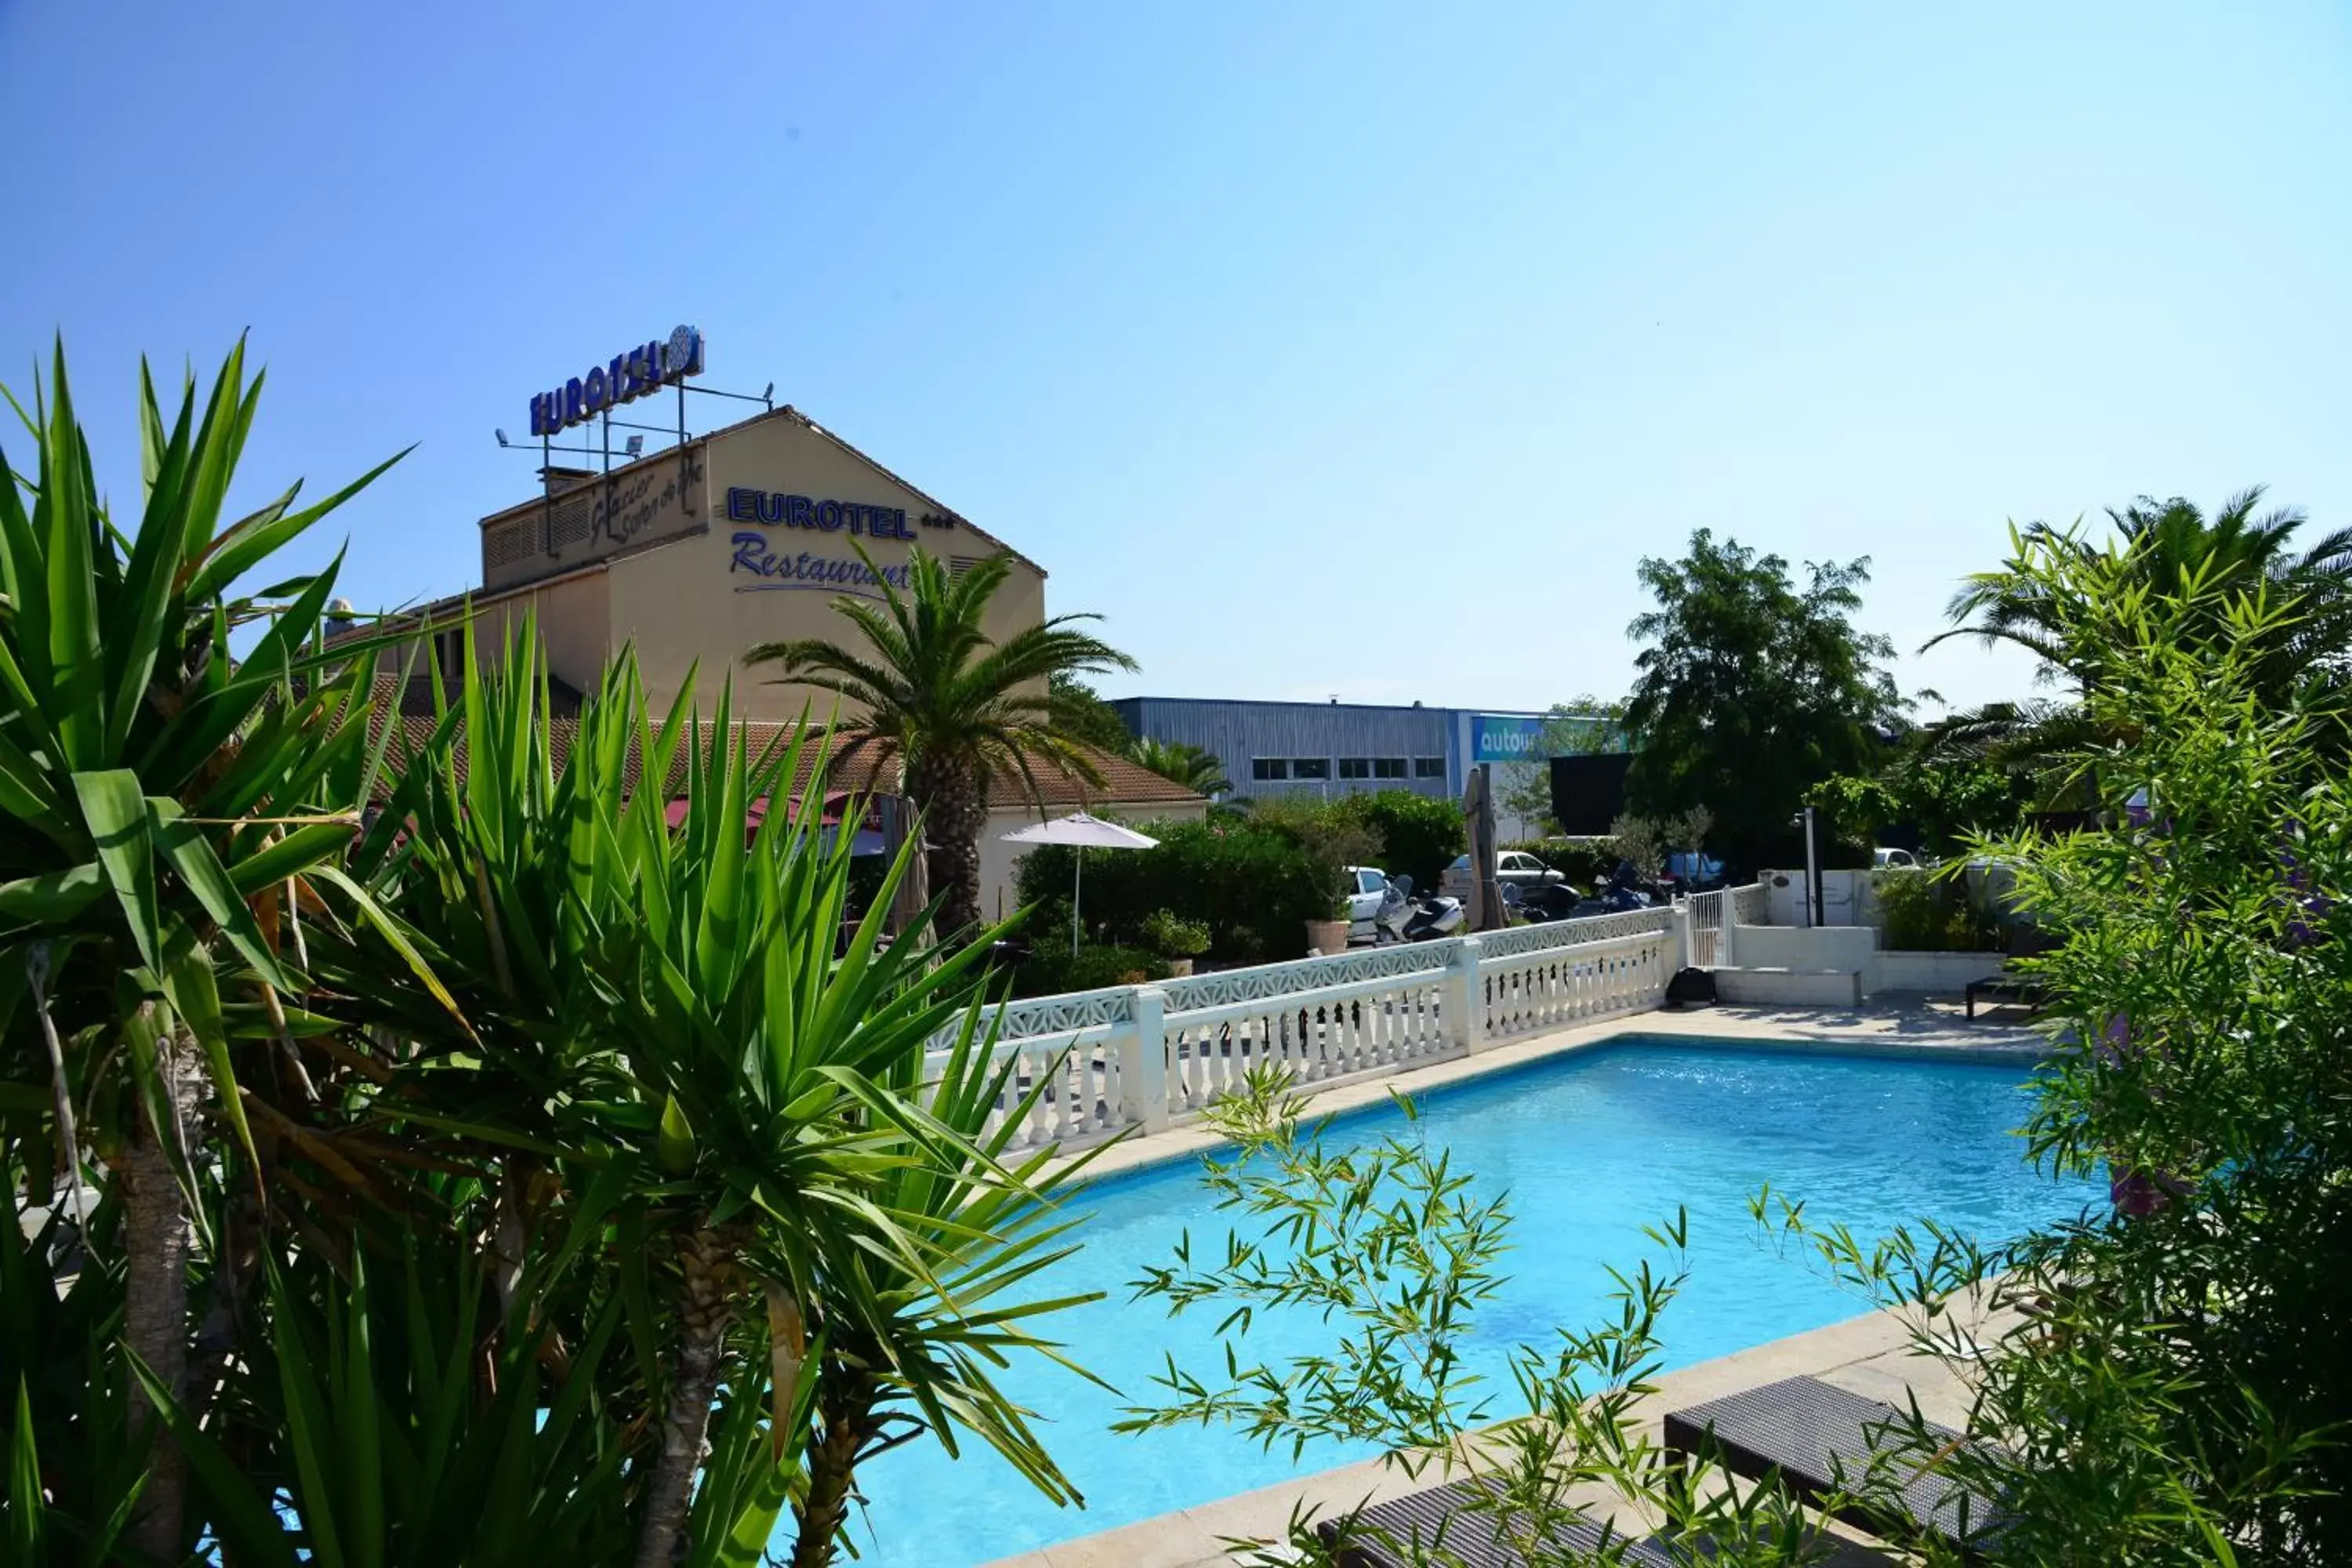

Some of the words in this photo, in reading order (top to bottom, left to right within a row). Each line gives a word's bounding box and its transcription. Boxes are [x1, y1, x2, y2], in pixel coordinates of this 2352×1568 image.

[529, 339, 665, 437] EUROTEL
[728, 487, 917, 540] EUROTEL
[729, 532, 909, 589] Restaurant
